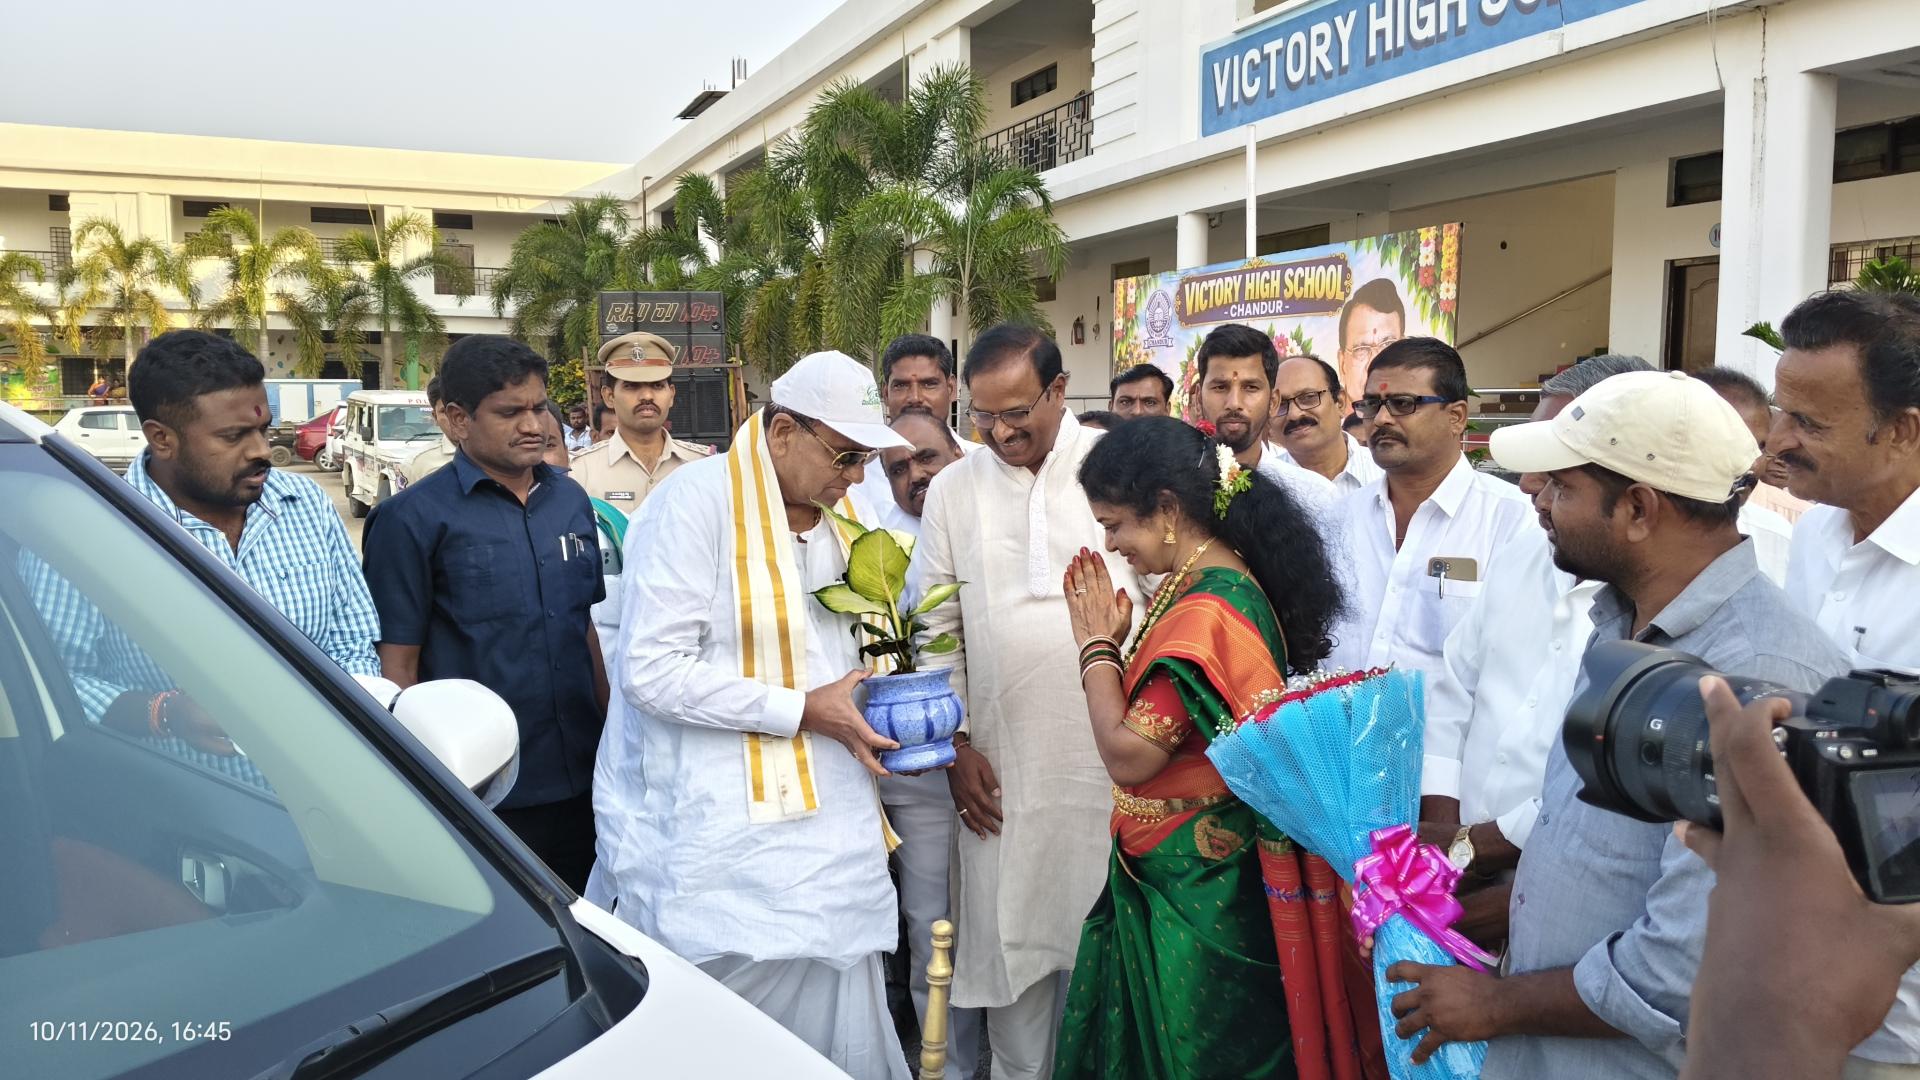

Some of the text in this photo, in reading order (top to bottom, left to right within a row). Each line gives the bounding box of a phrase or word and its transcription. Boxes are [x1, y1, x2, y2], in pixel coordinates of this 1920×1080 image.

[1213, 0, 1470, 109] VICTORY HIGH
[1184, 263, 1346, 316] VICTORY HIGH SCHOOL
[1649, 718, 1663, 730] G
